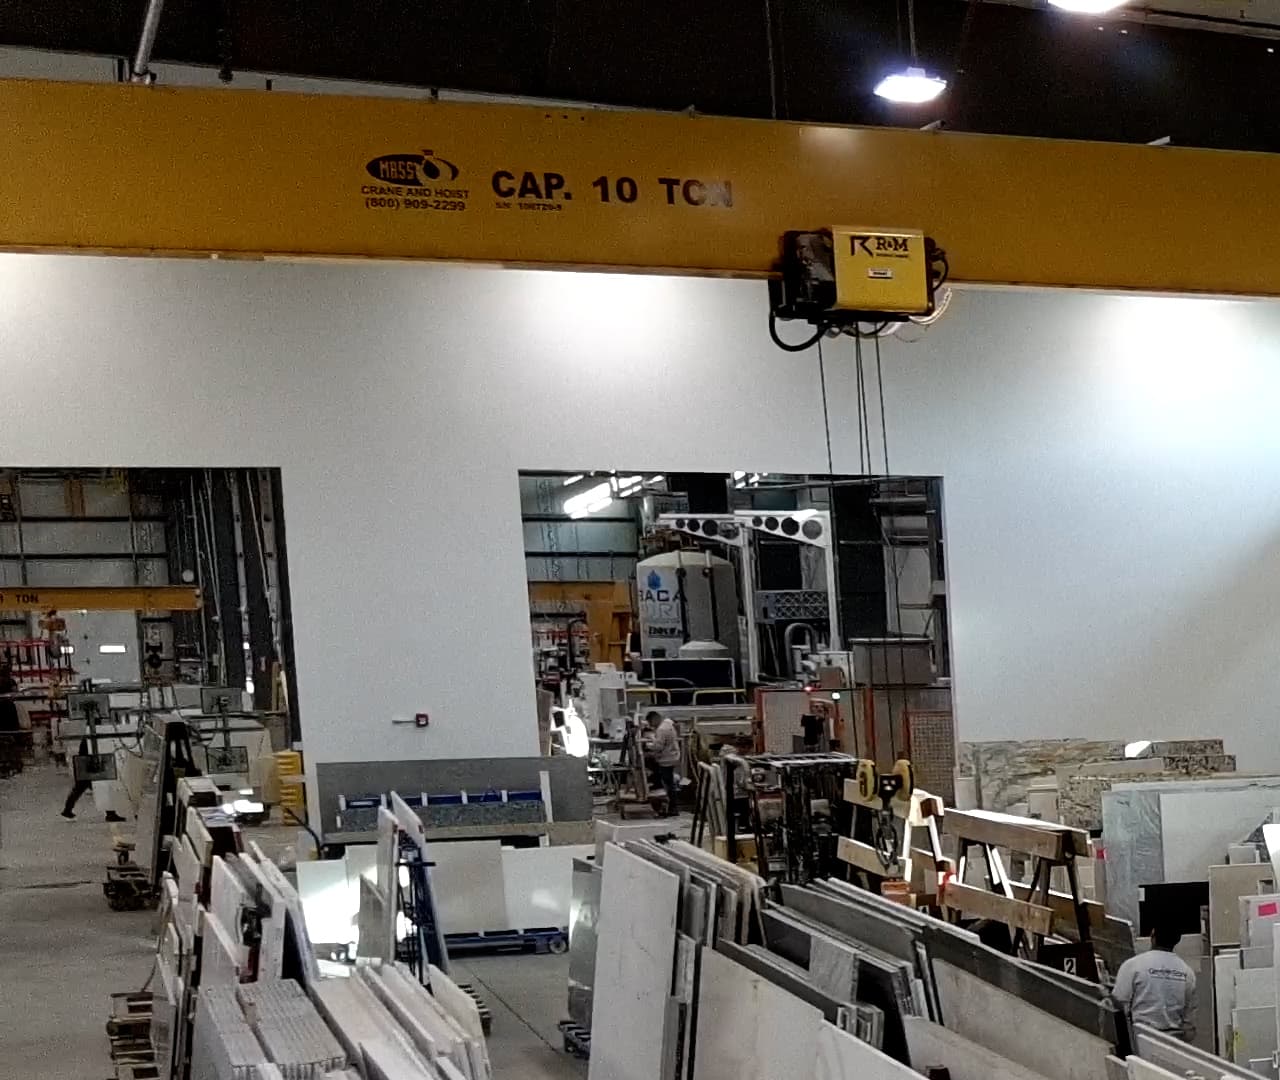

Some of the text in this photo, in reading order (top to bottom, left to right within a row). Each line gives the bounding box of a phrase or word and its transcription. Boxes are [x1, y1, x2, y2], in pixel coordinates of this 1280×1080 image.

[361, 185, 470, 199] CRANE AND HOIST
[491, 170, 572, 200] CAP.
[592, 175, 638, 203] 10
